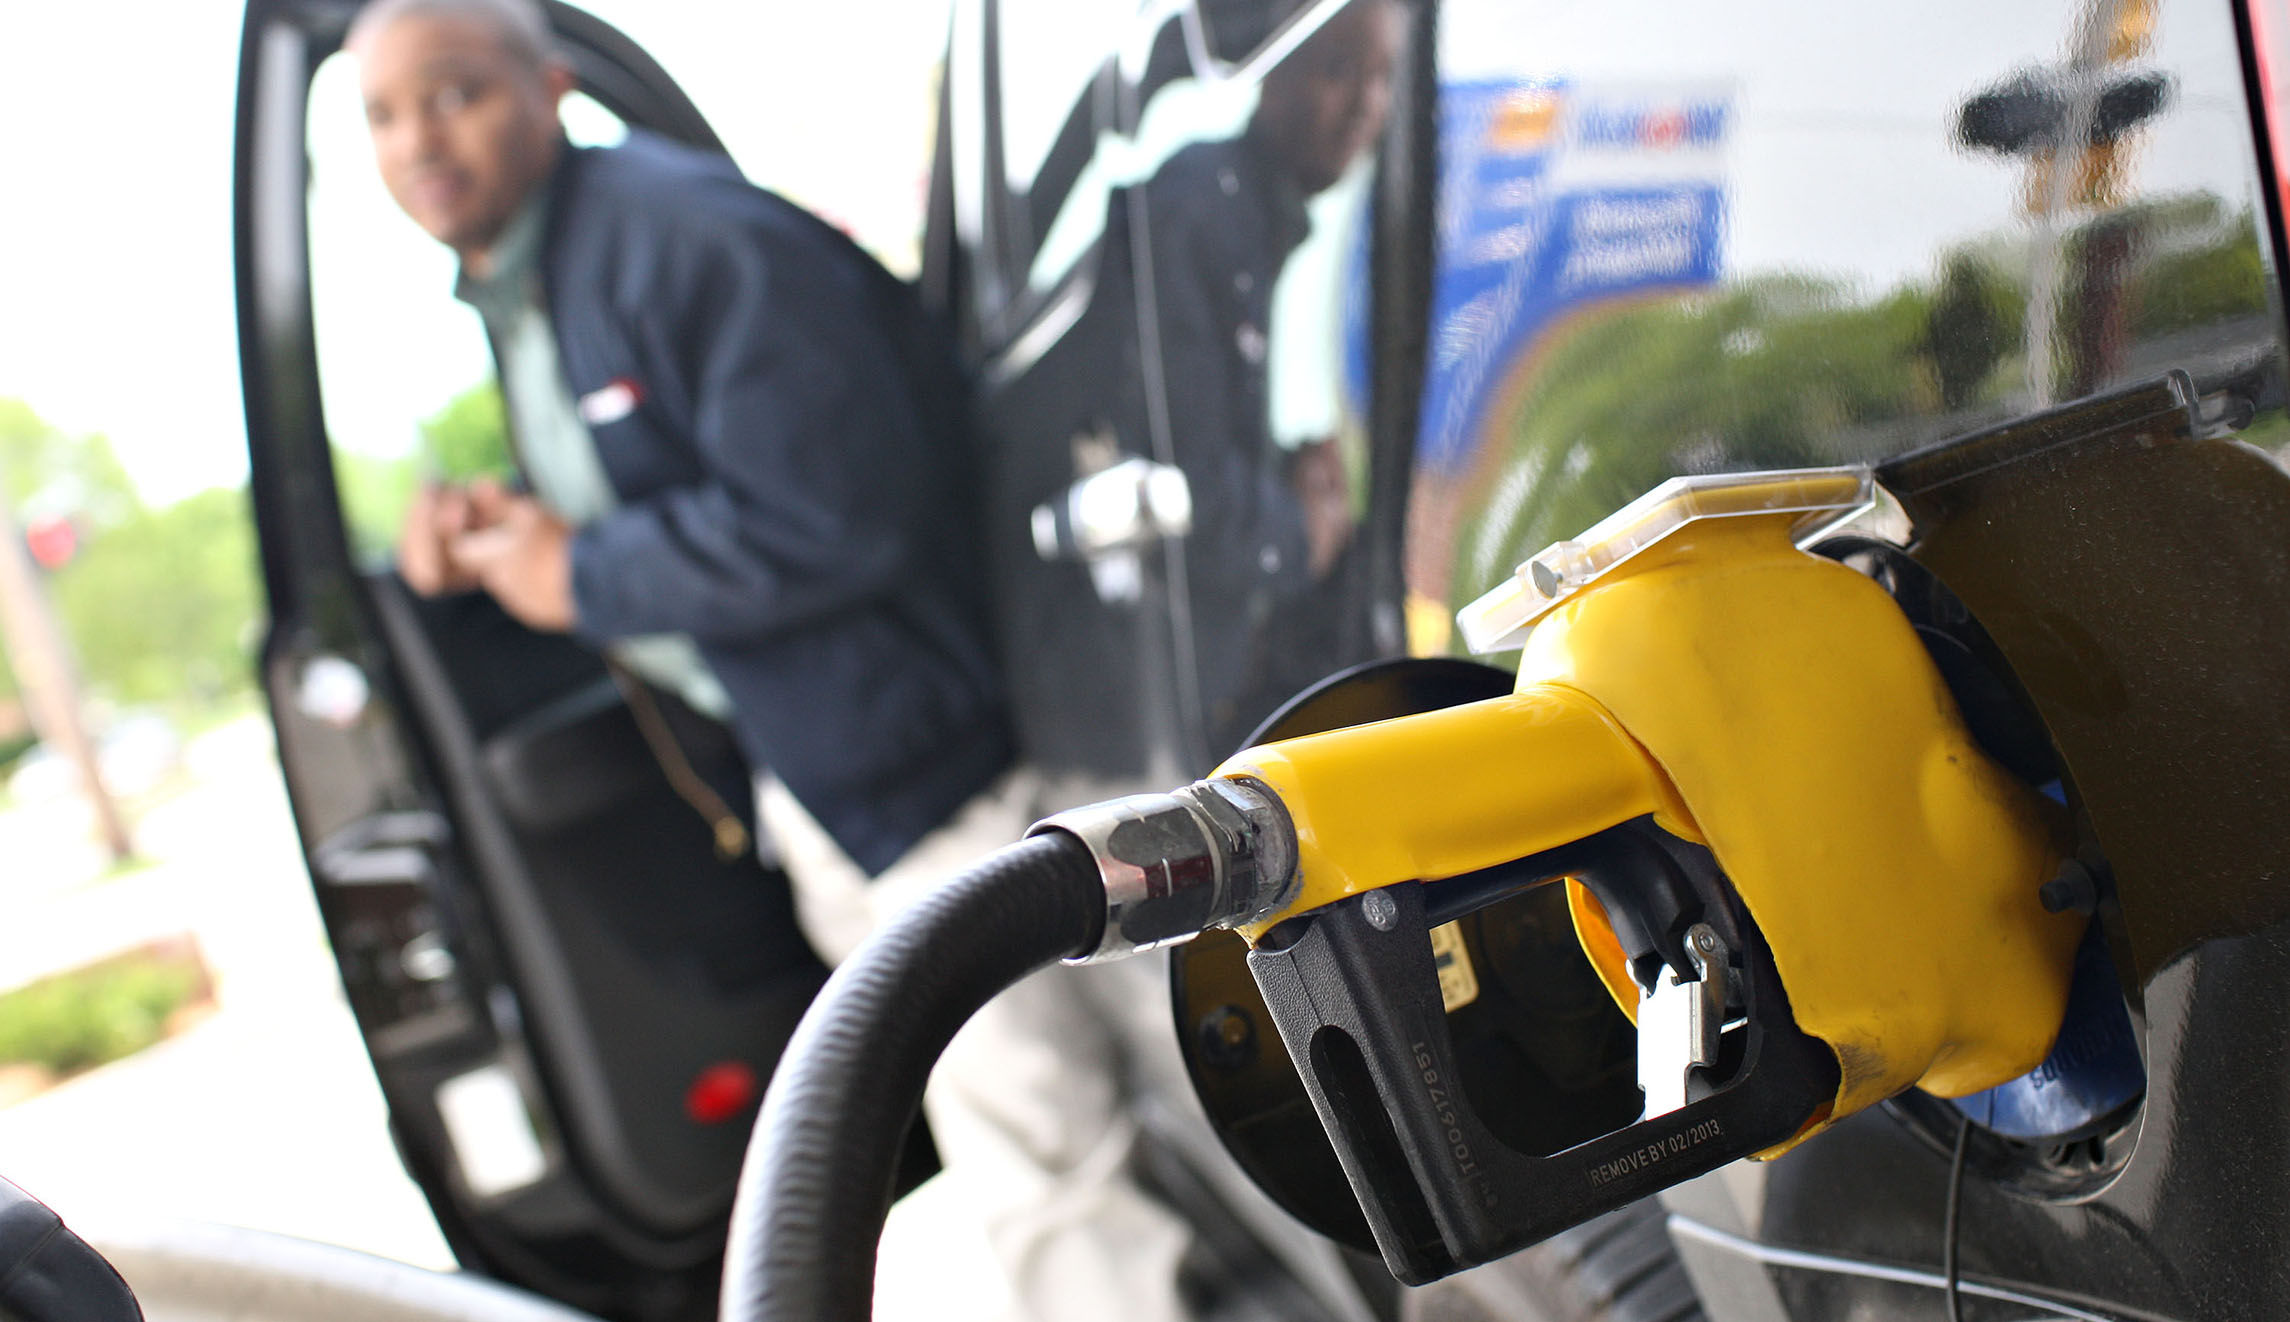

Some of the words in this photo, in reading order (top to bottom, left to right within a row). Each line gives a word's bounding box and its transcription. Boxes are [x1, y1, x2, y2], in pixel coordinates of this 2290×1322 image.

[1590, 1149, 1649, 1187] REMOVE
[1648, 1140, 1668, 1163] BY
[1669, 1119, 1720, 1152] 02/2013
